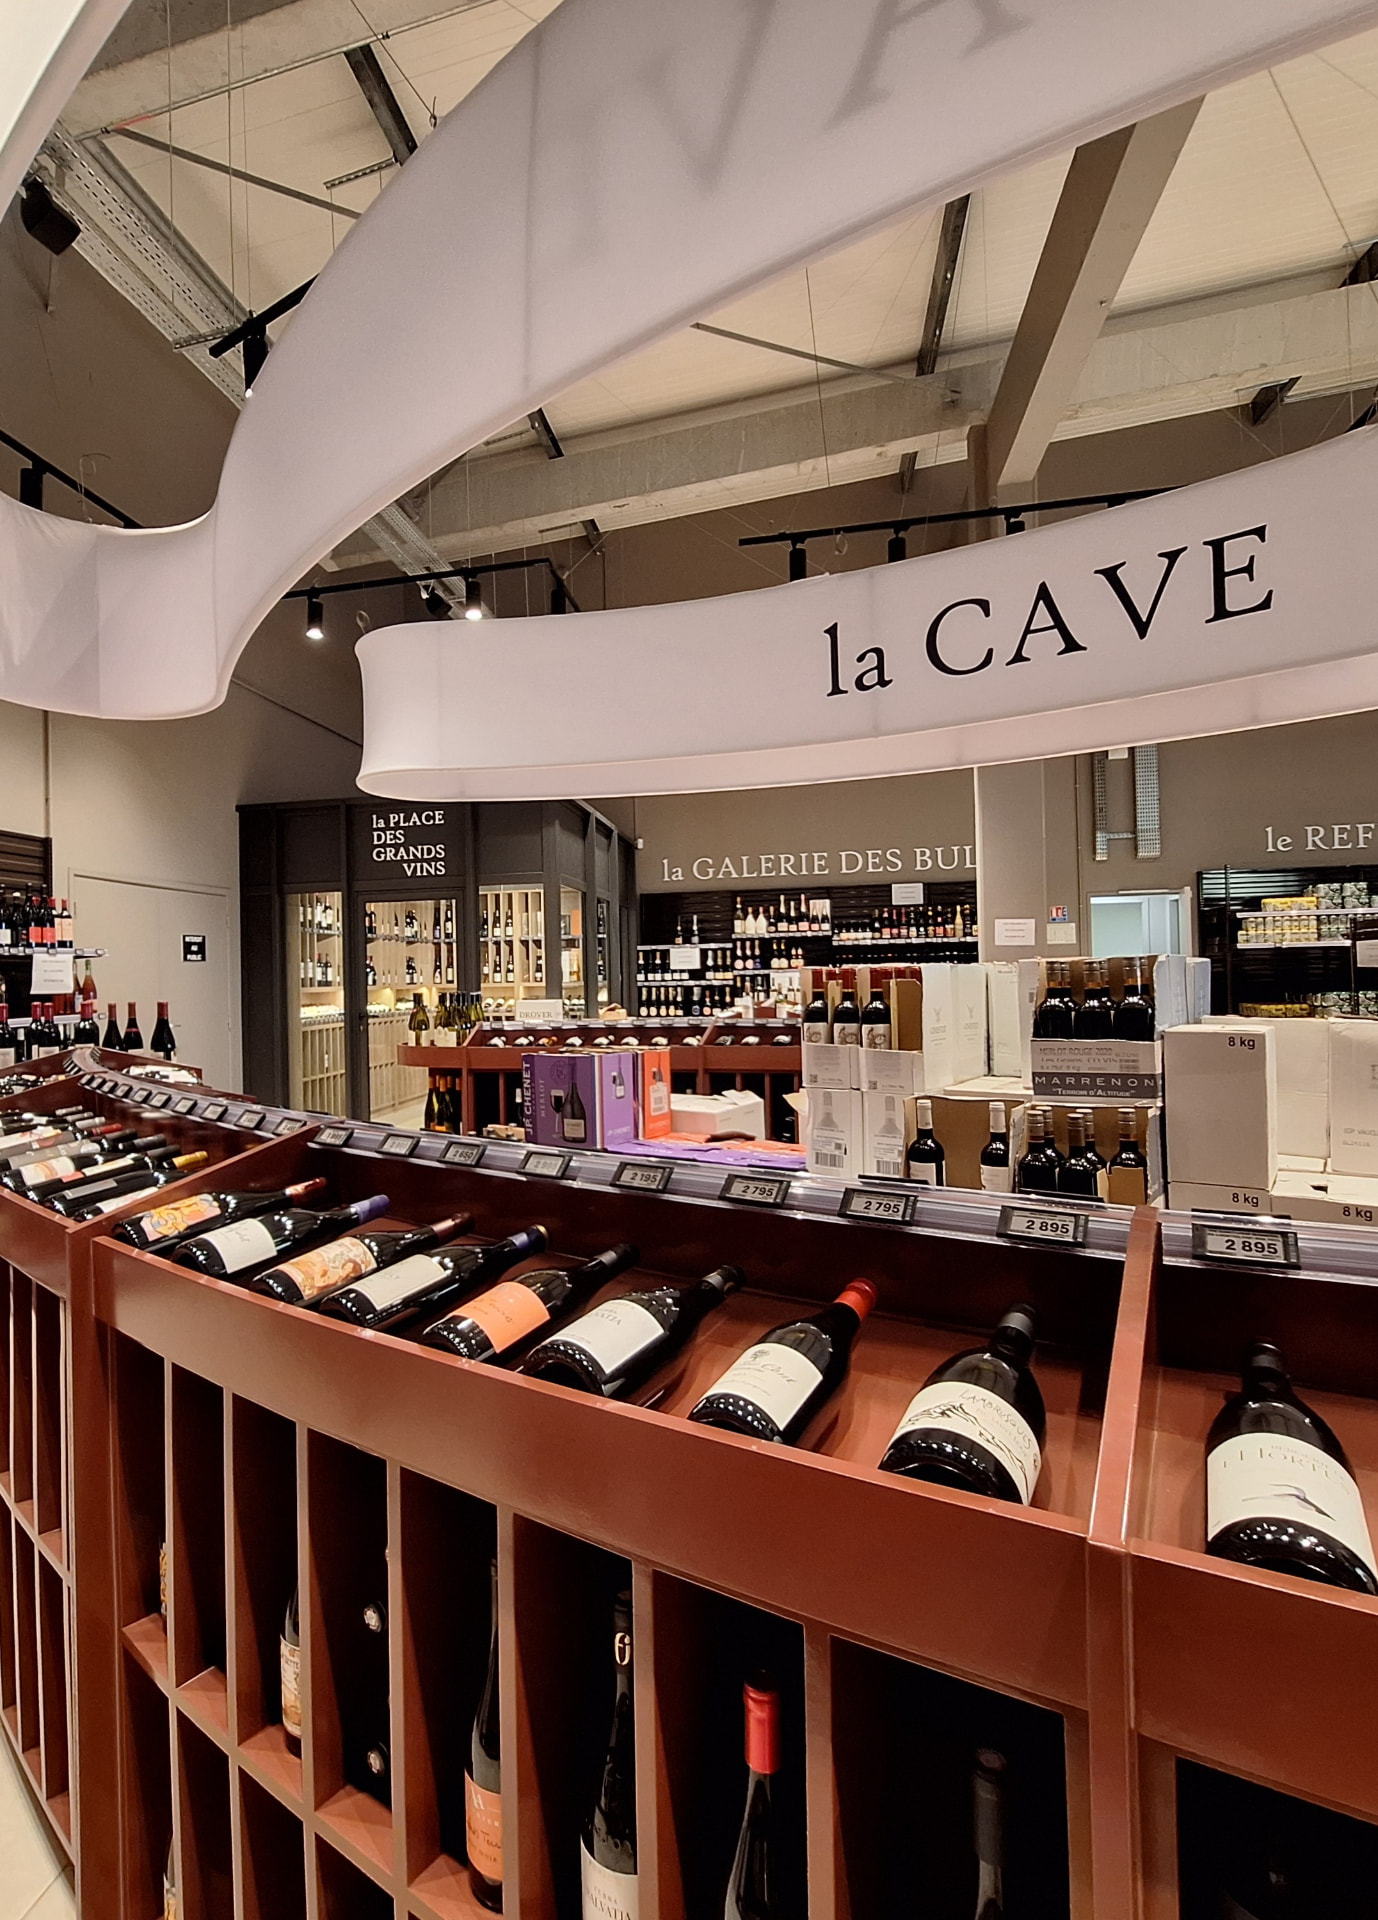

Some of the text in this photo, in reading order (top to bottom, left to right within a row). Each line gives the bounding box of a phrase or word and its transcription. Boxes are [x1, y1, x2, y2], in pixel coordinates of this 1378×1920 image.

[823, 523, 1274, 697] la CAVE
[372, 810, 445, 828] la PLACE
[372, 829, 405, 845] DES
[1265, 823, 1375, 852] le REF
[372, 844, 445, 861] GRANDS
[402, 861, 446, 877] VINS
[661, 845, 976, 882] la GALERIE DES BUL
[1228, 1036, 1256, 1050] 8 kg
[522, 1061, 532, 1115] CHENET
[1034, 1076, 1155, 1087] MARRENON
[630, 1171, 658, 1184] 2 195
[742, 1184, 774, 1197] 2 795
[863, 1200, 901, 1214] 2 795
[1232, 1192, 1259, 1207] 8 kg
[1343, 1206, 1373, 1221] 8 kg
[1026, 1219, 1070, 1234] 2 895
[1225, 1238, 1278, 1255] 2 895
